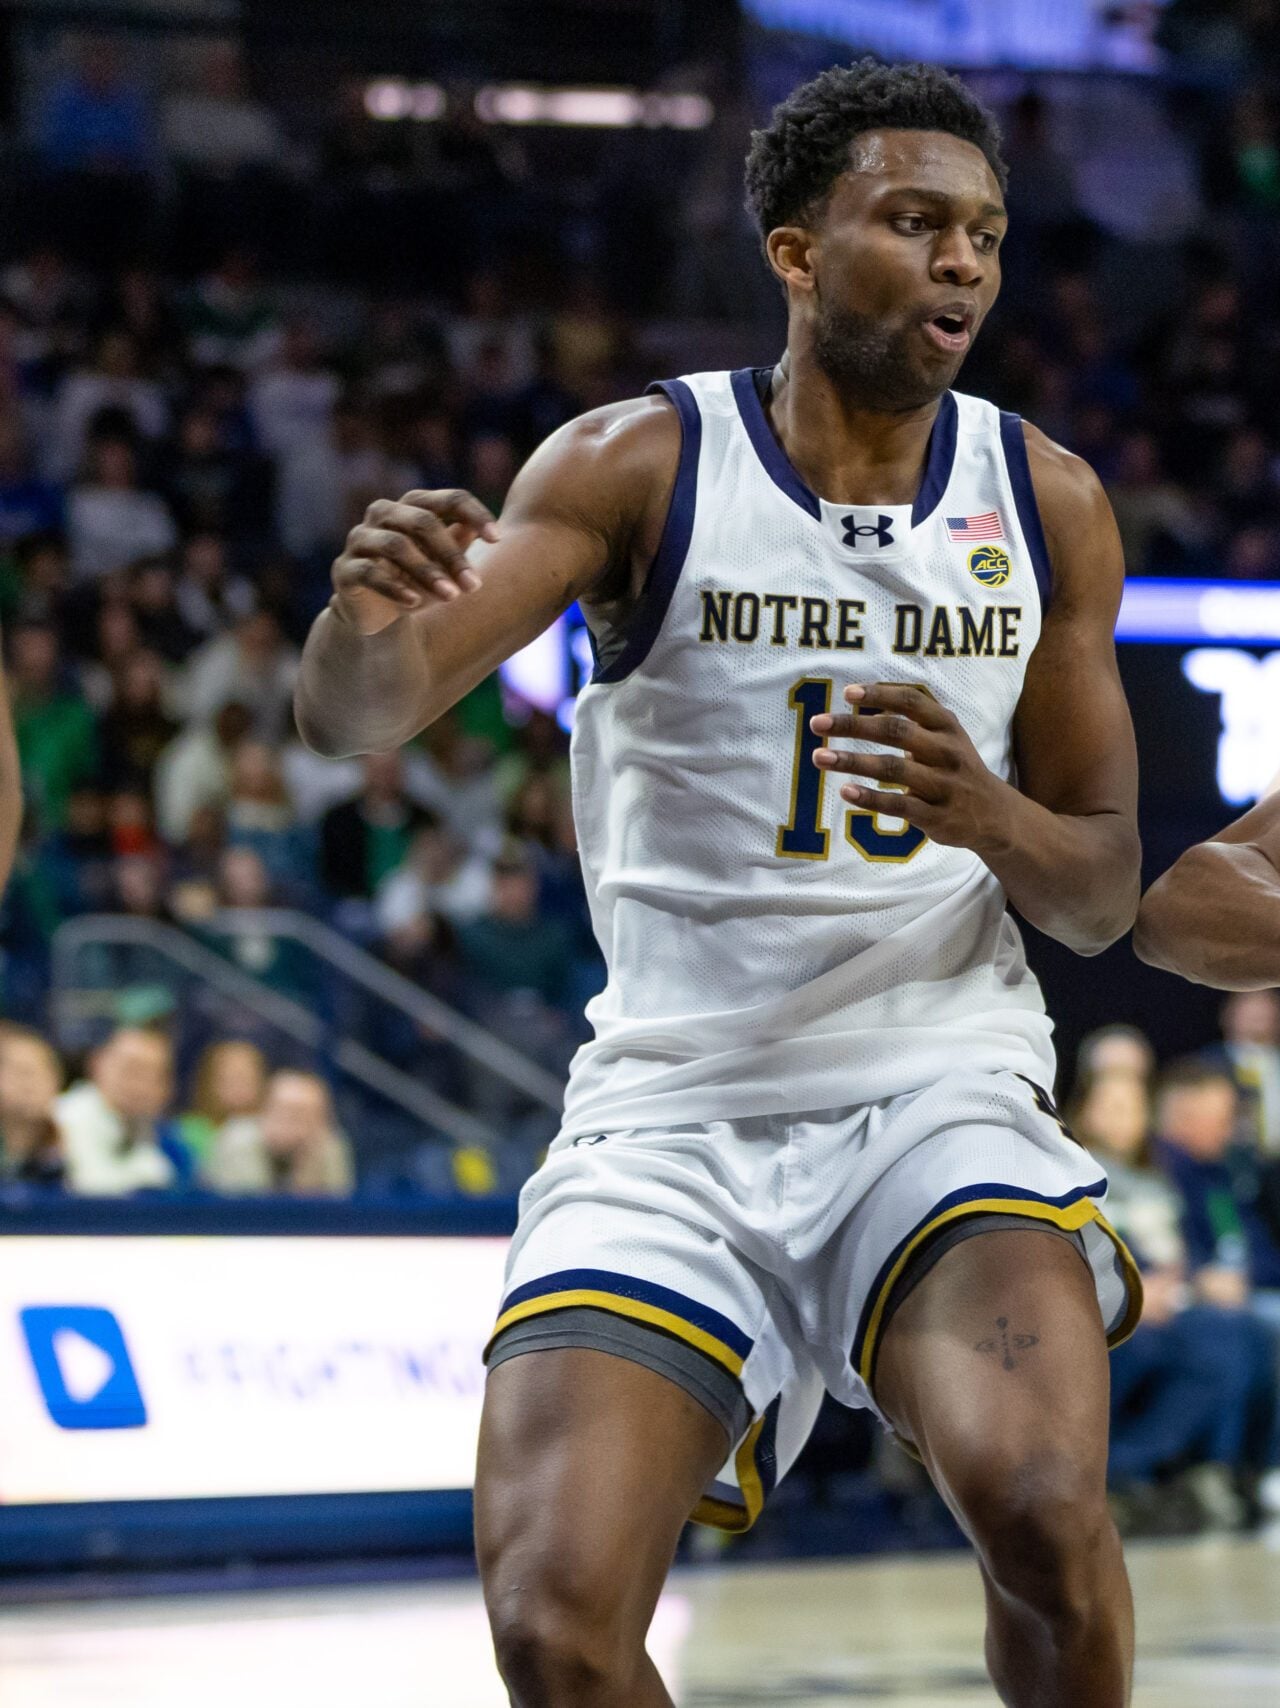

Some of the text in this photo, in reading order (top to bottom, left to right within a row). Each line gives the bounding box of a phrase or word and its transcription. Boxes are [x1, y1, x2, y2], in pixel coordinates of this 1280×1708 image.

[973, 555, 1009, 571] ACC
[699, 590, 1023, 659] NOTRE DAME
